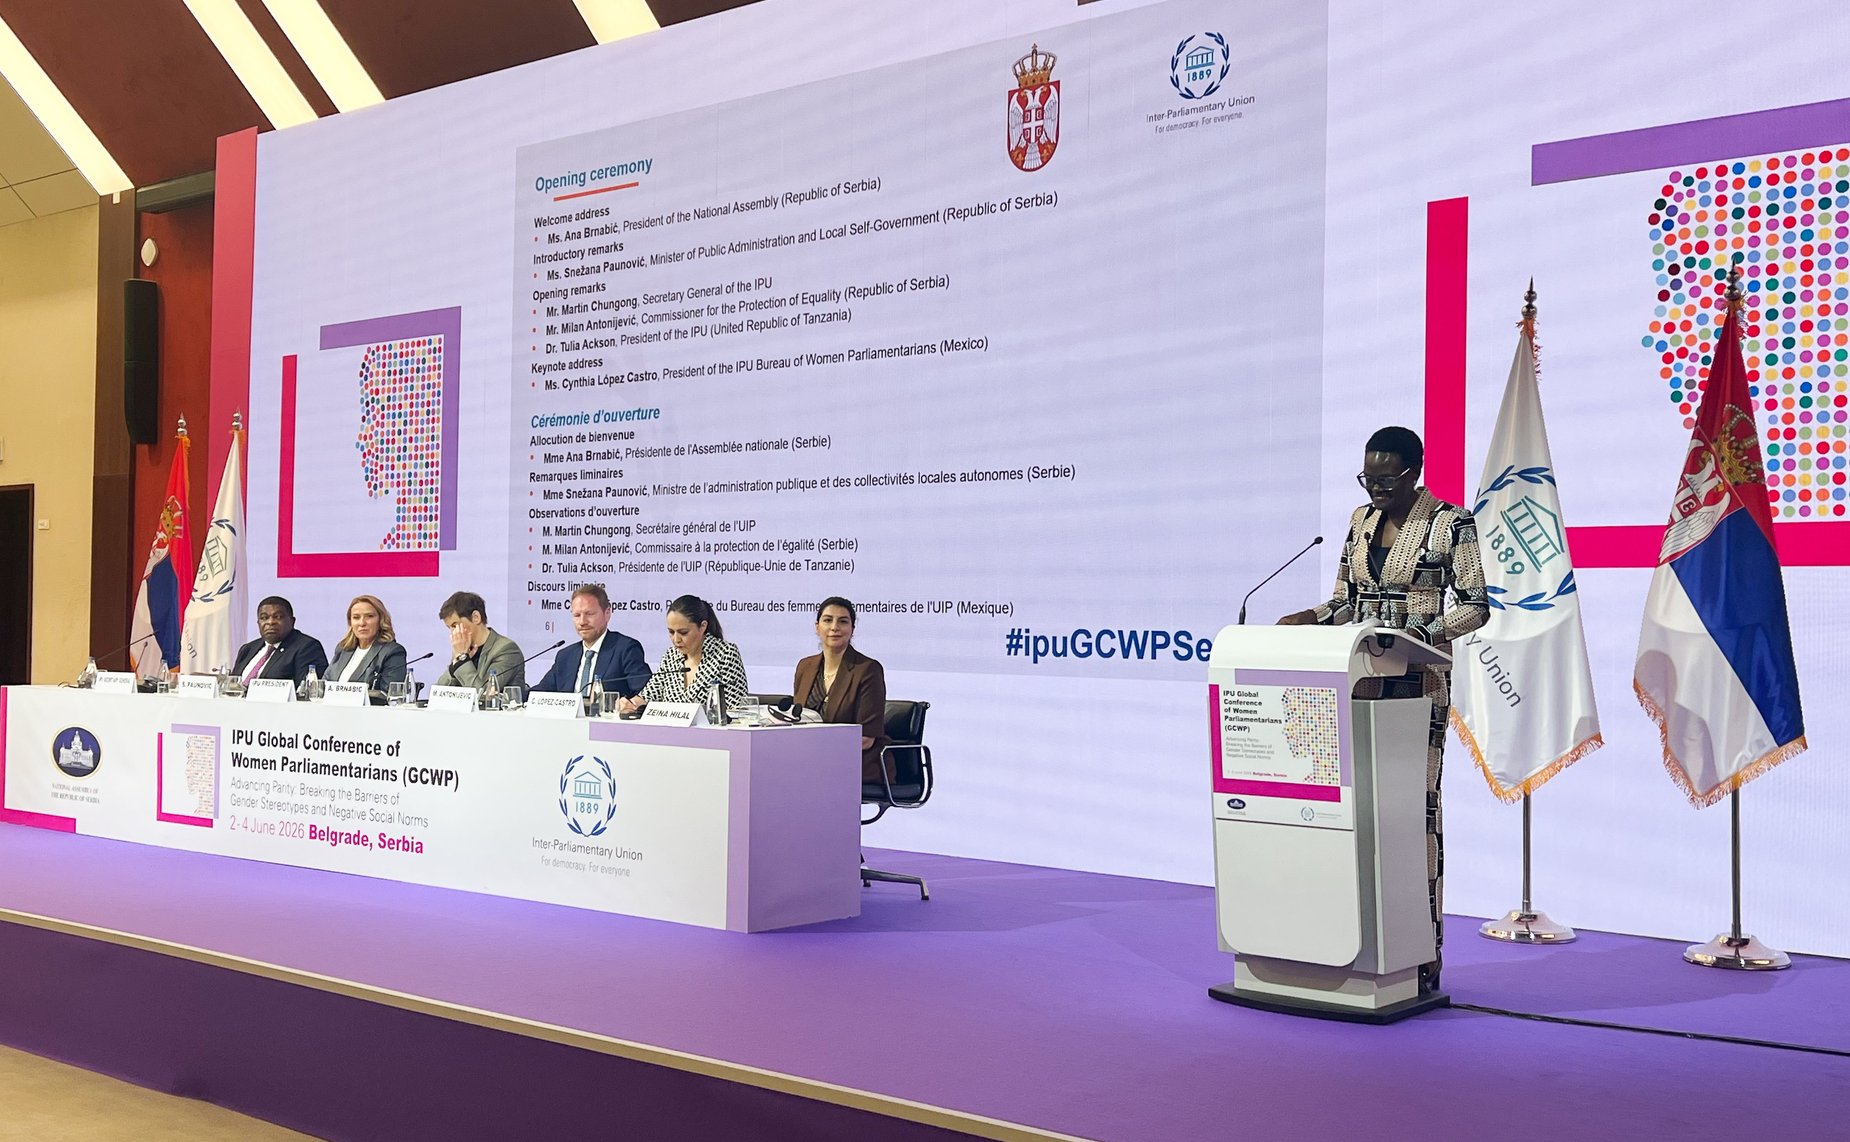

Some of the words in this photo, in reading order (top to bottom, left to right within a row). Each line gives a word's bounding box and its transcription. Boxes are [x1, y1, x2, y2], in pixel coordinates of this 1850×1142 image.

[1187, 69, 1212, 82] 1889
[1146, 102, 1226, 123] Inter-Parliamentary
[1228, 95, 1255, 107] Union
[1201, 116, 1212, 125] For
[535, 170, 586, 193] Opening
[589, 158, 653, 180] ceremony
[533, 213, 572, 228] Welcome
[574, 206, 610, 221] address
[547, 232, 562, 244] Ms.
[563, 230, 581, 241] Ana
[583, 222, 620, 238] Brnabić,
[622, 214, 664, 231] President
[665, 211, 675, 224] of
[676, 210, 691, 222] the
[693, 202, 730, 220] National
[732, 195, 779, 213] Assembly
[781, 186, 828, 207] (Republic
[830, 182, 841, 196] of
[843, 176, 881, 194] Serbia)
[546, 269, 562, 280] Ms.
[563, 264, 600, 278] Snežana
[602, 255, 647, 272] Paunović,
[649, 251, 685, 265] Minister
[686, 247, 696, 260] of
[697, 244, 726, 258] Public
[727, 234, 795, 253] Administration
[797, 228, 816, 243] and
[819, 224, 846, 240] Local
[849, 210, 940, 235] Self-Government
[942, 201, 997, 224] (Republic
[999, 197, 1011, 212] of
[1014, 191, 1058, 209] Serbia)
[533, 248, 585, 264] Introductory
[587, 241, 624, 256] remarks
[532, 287, 568, 303] Opening
[570, 281, 606, 296] remarks
[546, 305, 559, 317] Mr.
[561, 302, 588, 315] Martin
[590, 297, 640, 311] Chungong,
[642, 290, 684, 304] Secretary
[686, 283, 722, 299] General
[725, 281, 735, 294] of
[736, 280, 752, 292] the
[754, 276, 772, 290] IPU
[531, 360, 566, 375] Keynote
[567, 357, 603, 369] address
[544, 379, 560, 390] Ms.
[561, 375, 595, 391] Cynthia
[597, 373, 625, 387] López
[626, 370, 660, 382] Castro,
[662, 364, 705, 379] President
[706, 362, 717, 375] of
[718, 362, 733, 374] the
[735, 359, 753, 372] IPU
[756, 358, 791, 370] Bureau
[793, 353, 804, 367] of
[805, 352, 844, 365] Women
[847, 342, 936, 361] Parliamentarians
[939, 336, 988, 355] (Mexico)
[530, 411, 590, 428] Cérémonie
[592, 407, 660, 423] d'ouverture
[529, 433, 573, 446] Allocution
[575, 431, 586, 443] de
[588, 430, 635, 442] bienvenue
[543, 452, 564, 463] Mme
[565, 450, 583, 462] Ana
[585, 448, 623, 461] Brnabić,
[624, 446, 671, 458] Présidente
[673, 444, 685, 456] de
[687, 440, 742, 454] l'Assemblée
[744, 437, 789, 451] nationale
[791, 434, 831, 451] (Serbie)
[529, 471, 578, 483] Remarques
[580, 467, 623, 479] liminaires
[528, 506, 586, 518] Observations
[587, 504, 640, 516] d'ouverture
[542, 525, 552, 536] M.
[554, 524, 582, 536] Martin
[583, 524, 633, 538] Chungong,
[635, 522, 680, 534] Secrétaire
[682, 520, 716, 536] général
[718, 520, 731, 532] de
[733, 518, 756, 531] l'UIP
[1485, 525, 1525, 575] 1889
[1006, 628, 1212, 664] #ipuGCWPSe
[1479, 646, 1521, 708] Union
[647, 708, 669, 717] ZEINA
[670, 710, 690, 720] HILAL
[1224, 715, 1282, 724] Parliamentarians
[1224, 725, 1250, 733] (GCWP)
[232, 729, 253, 745] IPU
[257, 731, 298, 748] Global
[302, 734, 381, 755] Conference
[386, 740, 400, 756] of
[231, 752, 276, 770] Women
[280, 756, 397, 781] Parliamentarians
[402, 767, 459, 791] (GCWP)
[230, 776, 270, 797] Advancing
[299, 782, 335, 801] Breaking
[337, 787, 352, 800] the
[353, 787, 389, 804] Barriers
[390, 792, 399, 805] of
[230, 793, 258, 808] Gender
[260, 796, 309, 814] Stereotypes
[310, 804, 326, 815] and
[328, 804, 366, 821] Negative
[368, 807, 395, 823] Social
[397, 811, 430, 827] Norms
[575, 802, 599, 814] 1889
[251, 818, 275, 835] June
[279, 821, 305, 839] 2026
[309, 824, 373, 850] Belgrade,
[378, 833, 424, 854] Serbia
[532, 837, 613, 860] Inter-Parliamentary
[615, 847, 643, 861] Union
[541, 855, 551, 866] For
[589, 861, 599, 872] For
